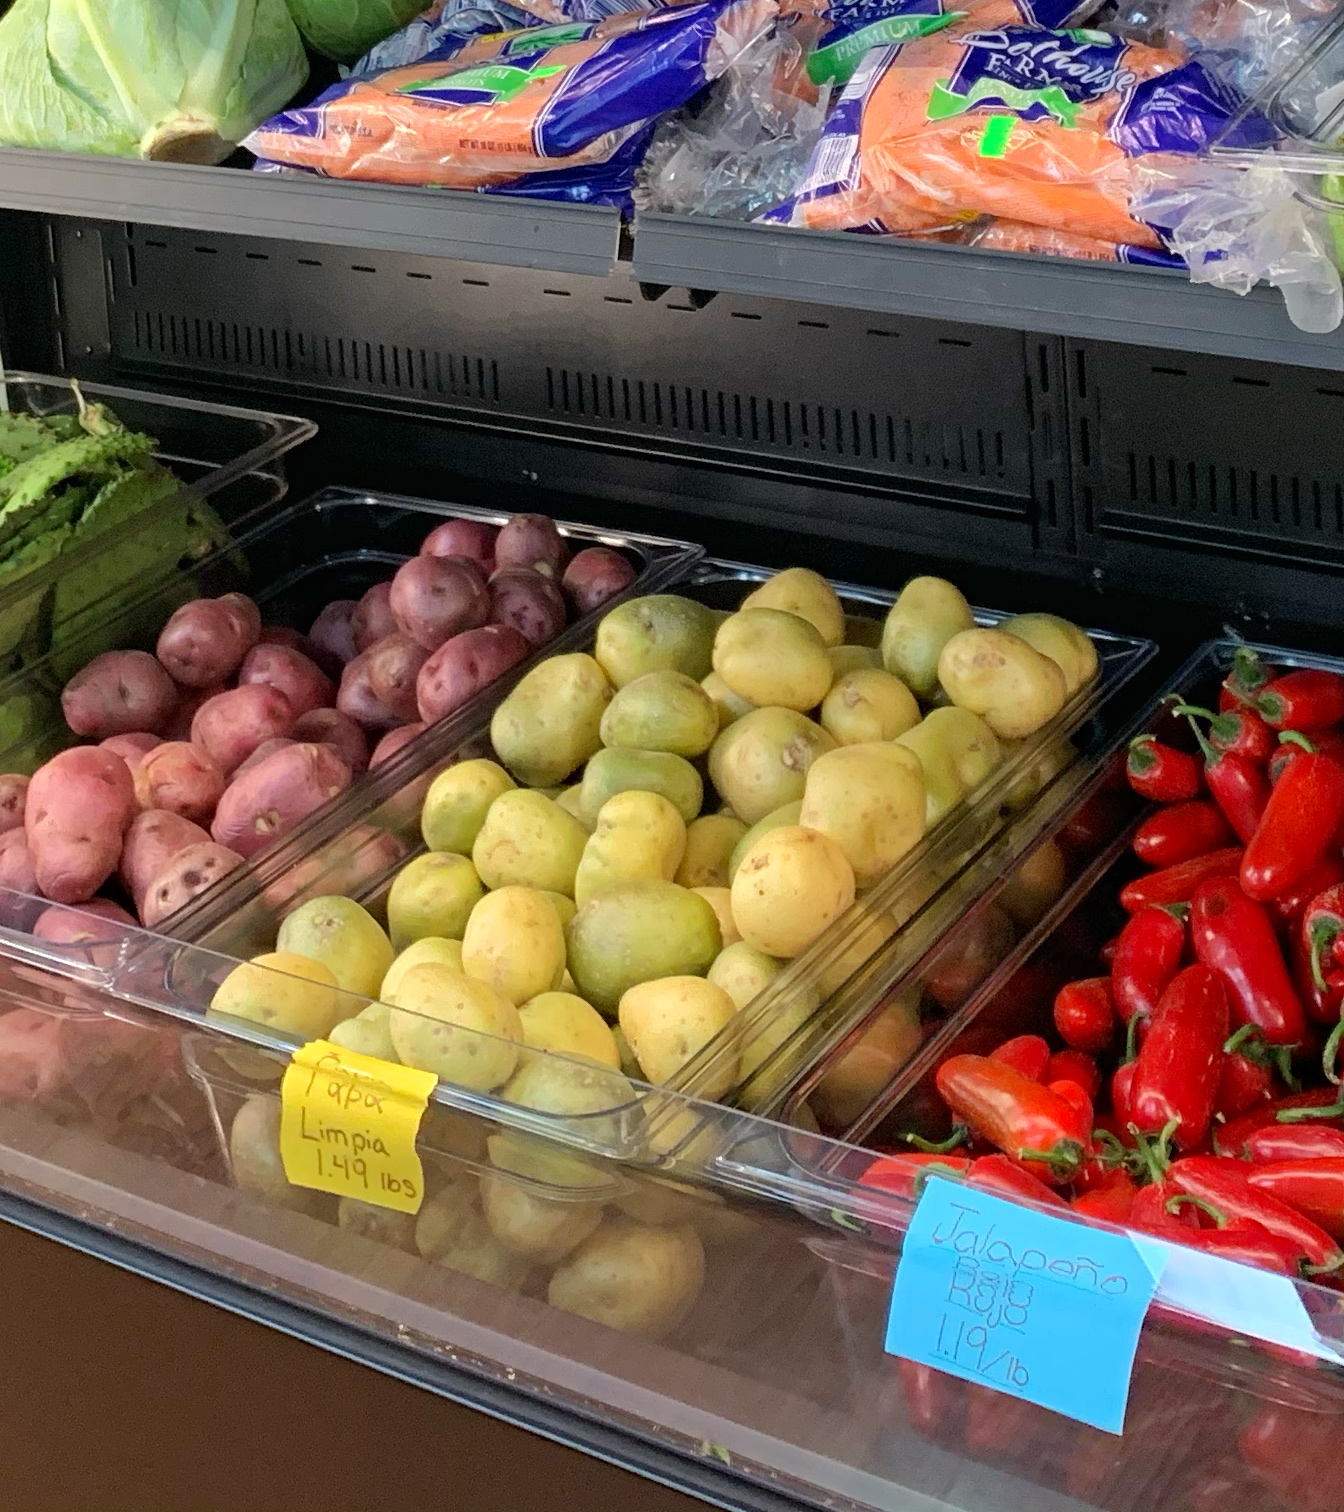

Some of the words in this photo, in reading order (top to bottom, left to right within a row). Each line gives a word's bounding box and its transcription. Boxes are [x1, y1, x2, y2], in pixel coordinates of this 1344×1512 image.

[835, 20, 921, 62] PREMIUM
[305, 1051, 384, 1115] Papa
[300, 1106, 390, 1157] Limpia
[317, 1149, 369, 1189] 1.49
[381, 1172, 417, 1200] lbs
[931, 1203, 1128, 1296] Jalapeño
[936, 1313, 1030, 1387] 1.19/lb
